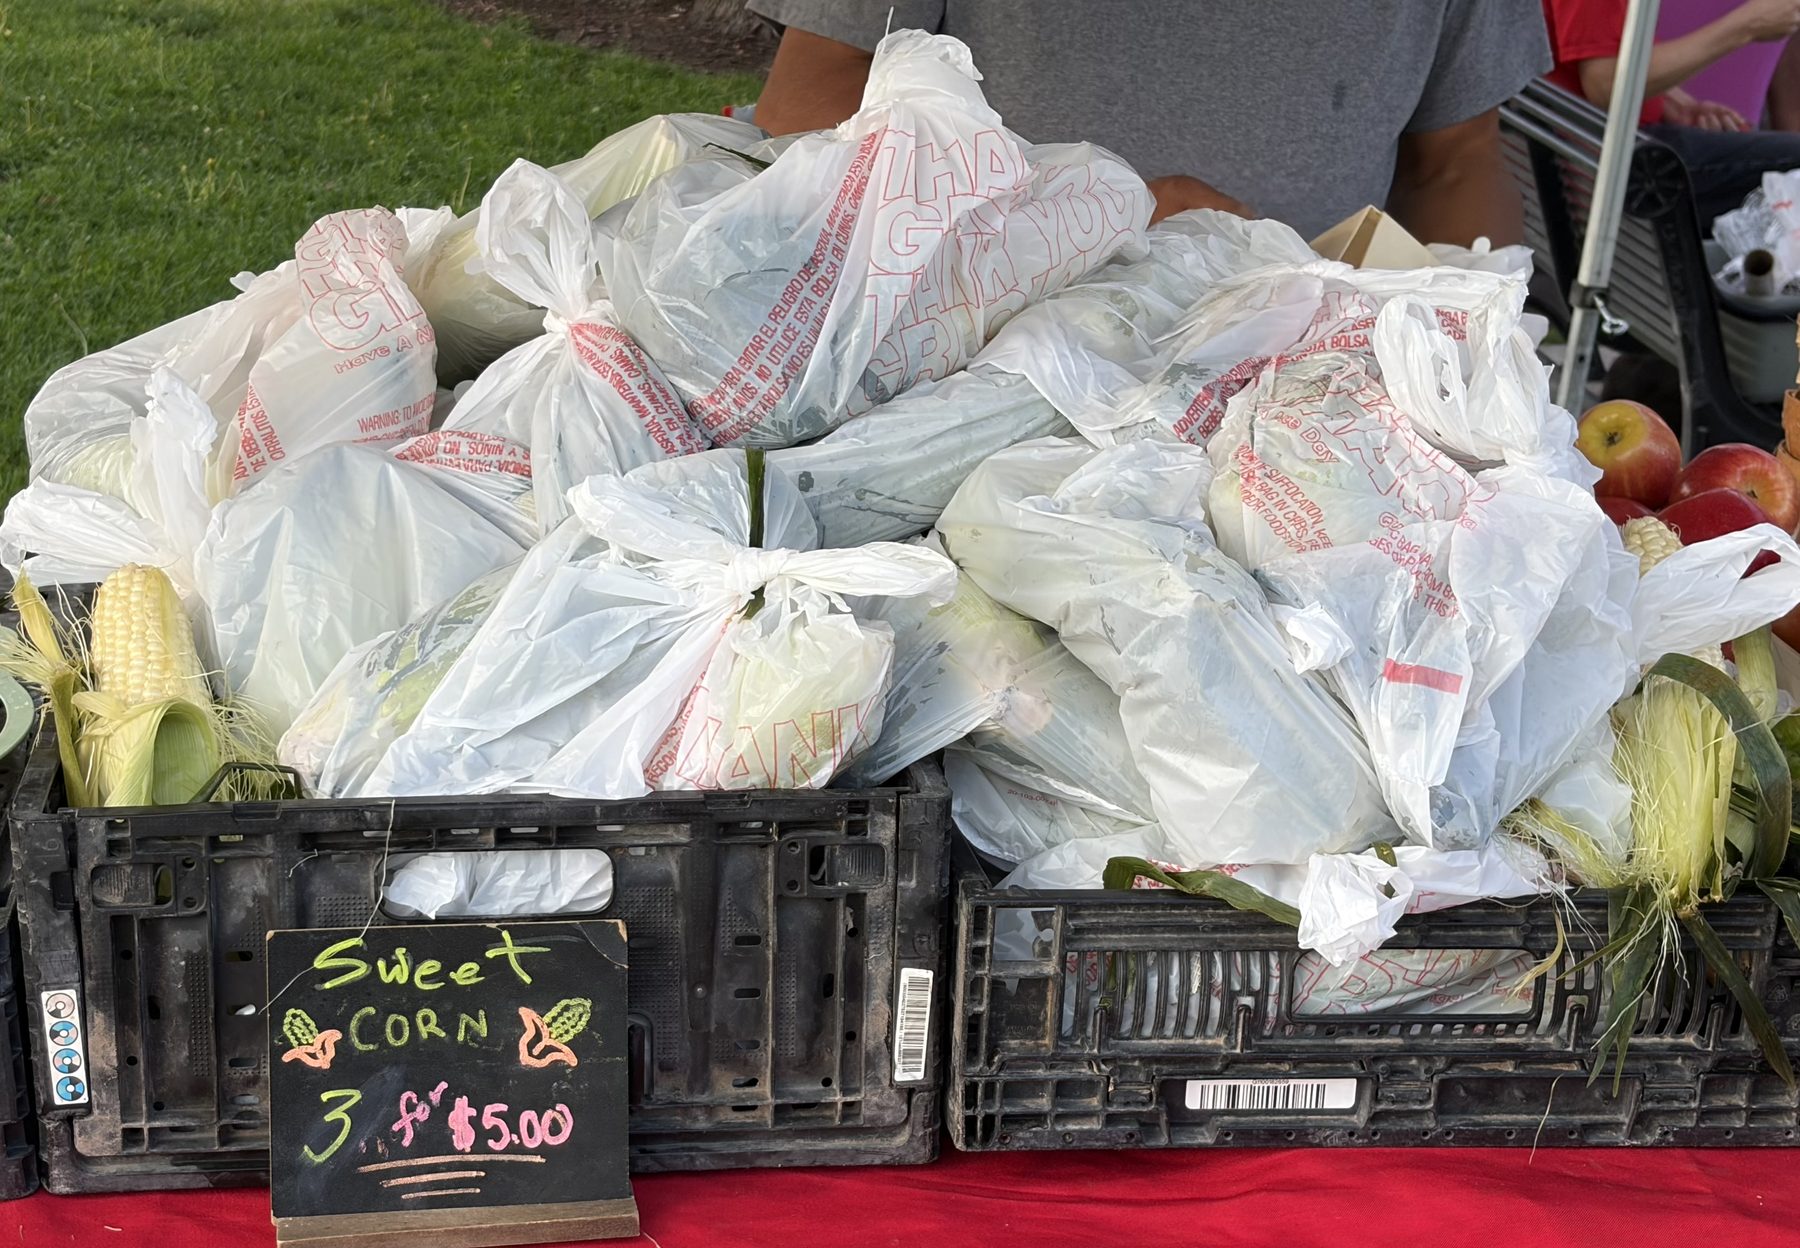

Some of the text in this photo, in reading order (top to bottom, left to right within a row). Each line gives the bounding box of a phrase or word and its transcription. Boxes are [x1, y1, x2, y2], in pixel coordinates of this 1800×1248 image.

[797, 265, 818, 282] DE
[755, 364, 772, 384] NO
[766, 322, 801, 366] UTILICE
[793, 296, 817, 325] ESTA
[810, 261, 840, 298] BOLSA
[832, 243, 846, 262] EN
[768, 278, 805, 325] PELIGRO
[396, 334, 413, 352] A
[759, 323, 778, 340] EL
[1331, 334, 1371, 349] BOLSA
[737, 334, 769, 371] EVITAR
[761, 371, 794, 407] BOLSA
[784, 354, 804, 375] NO
[796, 340, 814, 360] ES
[357, 409, 402, 433] WARNING:
[403, 405, 412, 422] TO
[664, 417, 680, 432] EN
[443, 441, 461, 455] NO
[1300, 427, 1340, 463] Day
[1256, 480, 1280, 501] BAG
[1272, 498, 1291, 512] IN
[1312, 527, 1335, 550] KEE
[1423, 593, 1450, 618] THIS
[313, 928, 552, 990] Sweet
[348, 1005, 489, 1052] CORN
[302, 1080, 575, 1164] 3 for $5.00
